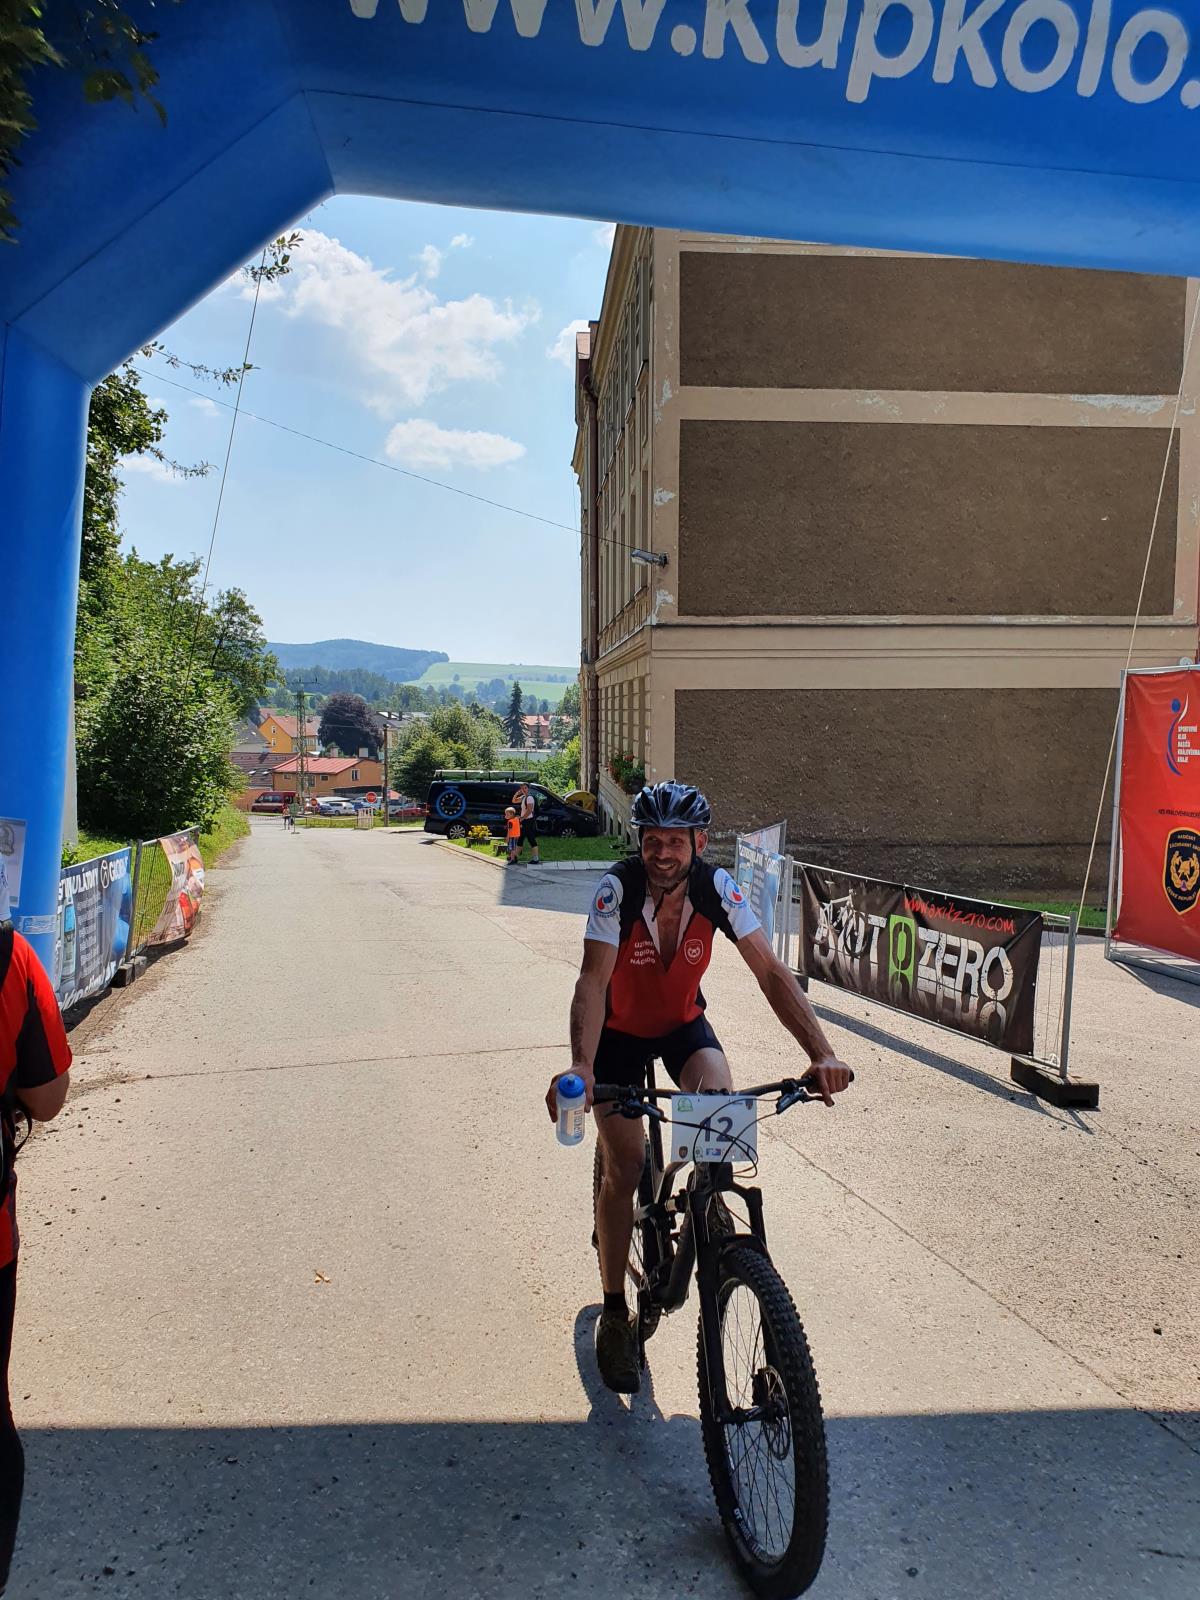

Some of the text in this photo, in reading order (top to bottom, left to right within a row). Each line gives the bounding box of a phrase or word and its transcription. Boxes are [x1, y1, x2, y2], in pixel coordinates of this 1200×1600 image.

[350, 0, 1200, 109] w.kupkolo.
[917, 926, 1014, 1001] ZERO
[700, 1116, 735, 1142] 12
